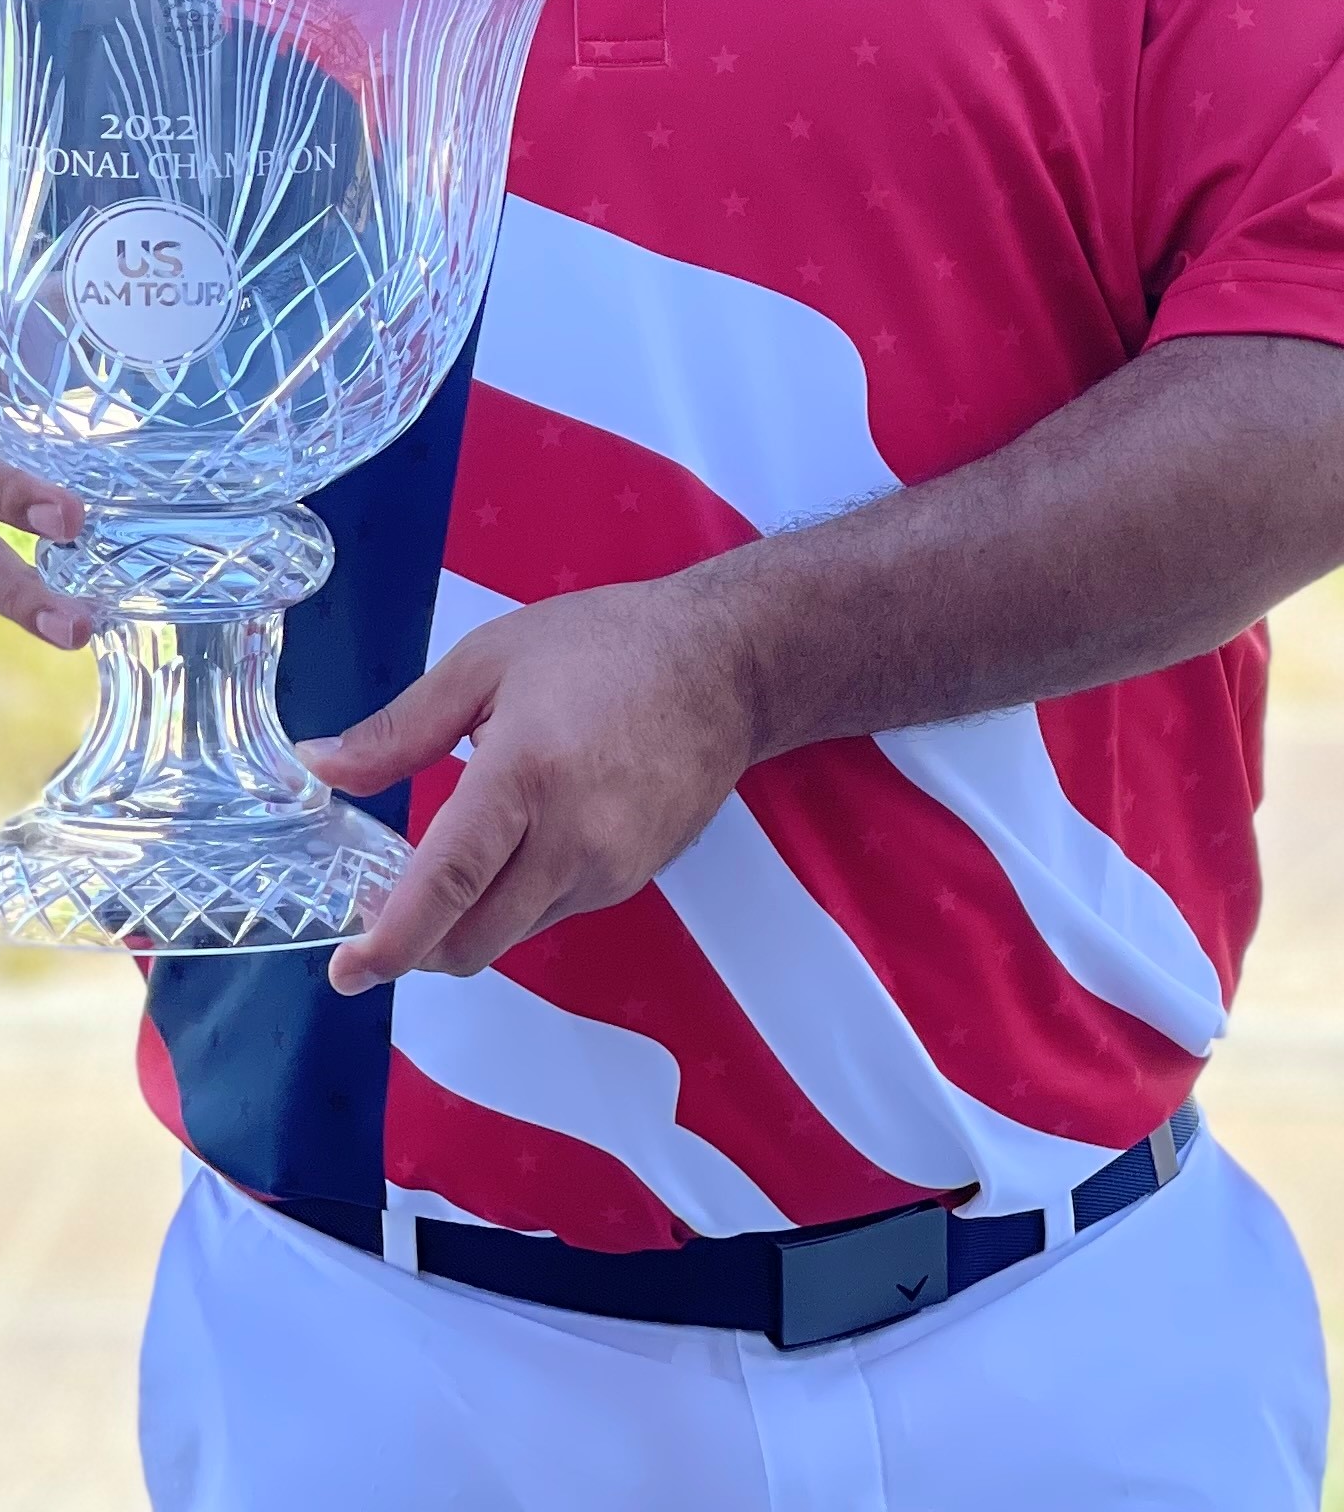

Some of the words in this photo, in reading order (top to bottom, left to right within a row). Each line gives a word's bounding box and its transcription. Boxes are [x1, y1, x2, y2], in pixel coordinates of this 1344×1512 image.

[100, 113, 199, 141] 2022
[148, 143, 337, 180] CHAMPION
[79, 280, 131, 307] AM
[136, 281, 227, 307] TOUR
